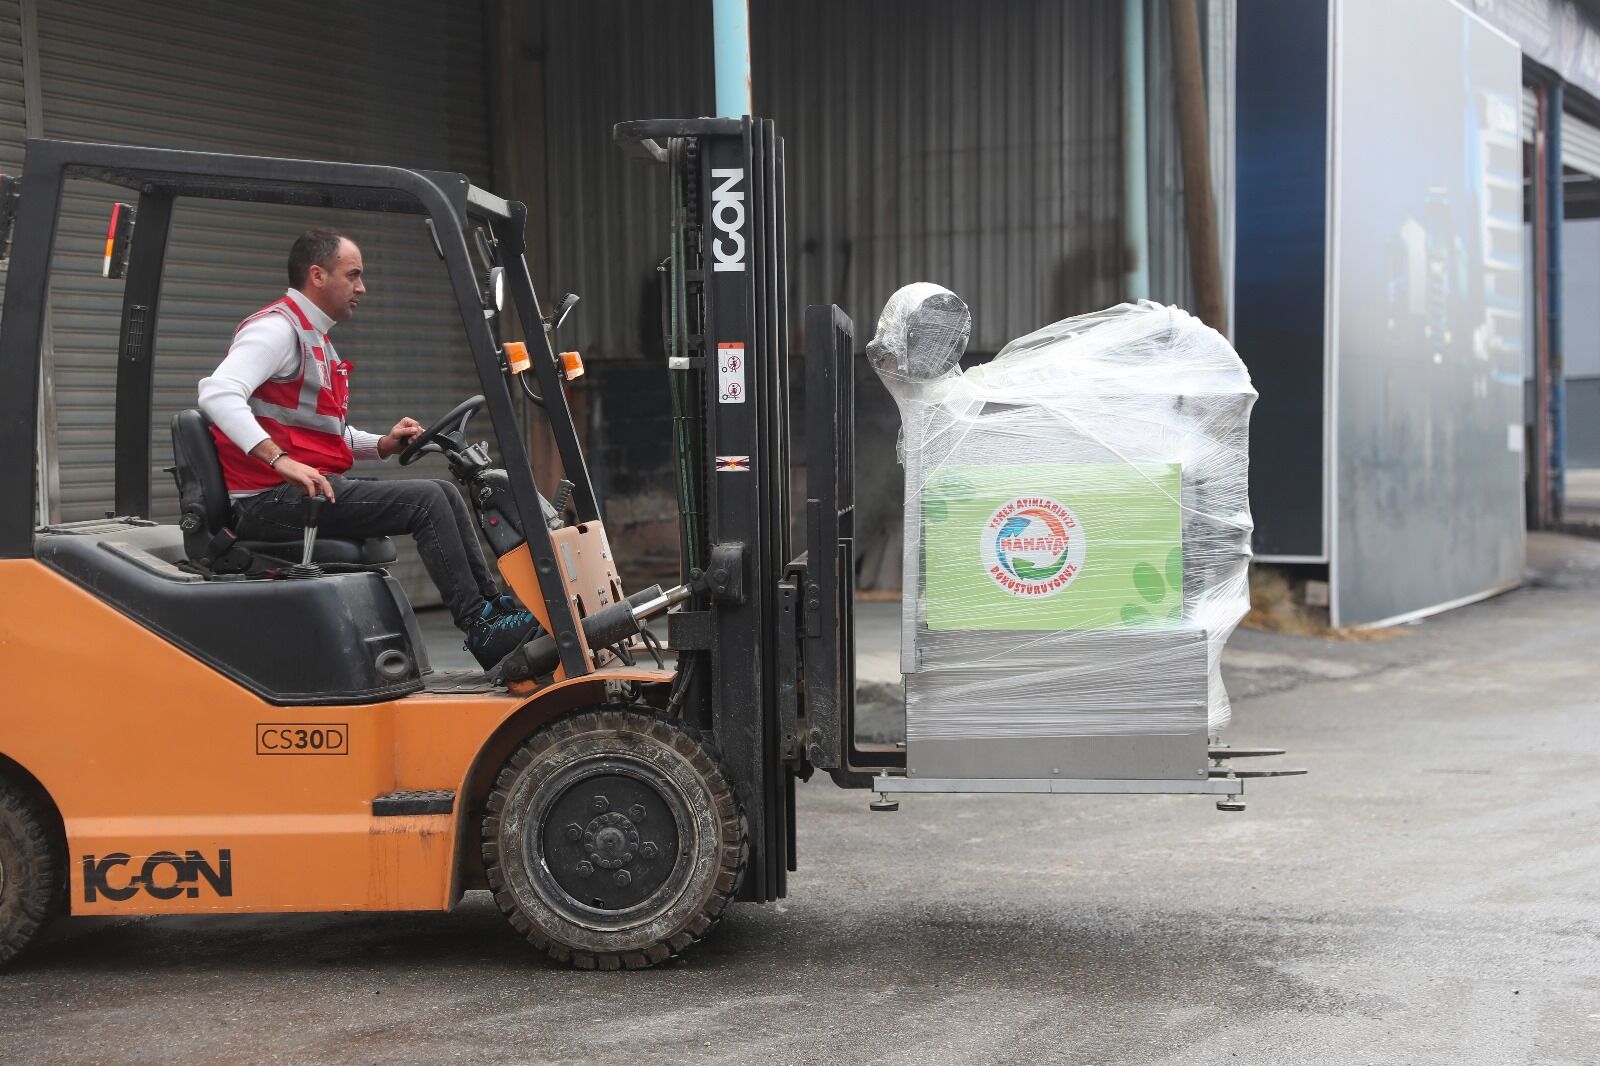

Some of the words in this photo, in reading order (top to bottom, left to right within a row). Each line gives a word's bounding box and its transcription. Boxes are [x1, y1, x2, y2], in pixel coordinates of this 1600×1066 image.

[712, 168, 745, 272] ICON
[261, 729, 343, 749] CS30D
[82, 848, 233, 903] ICON
